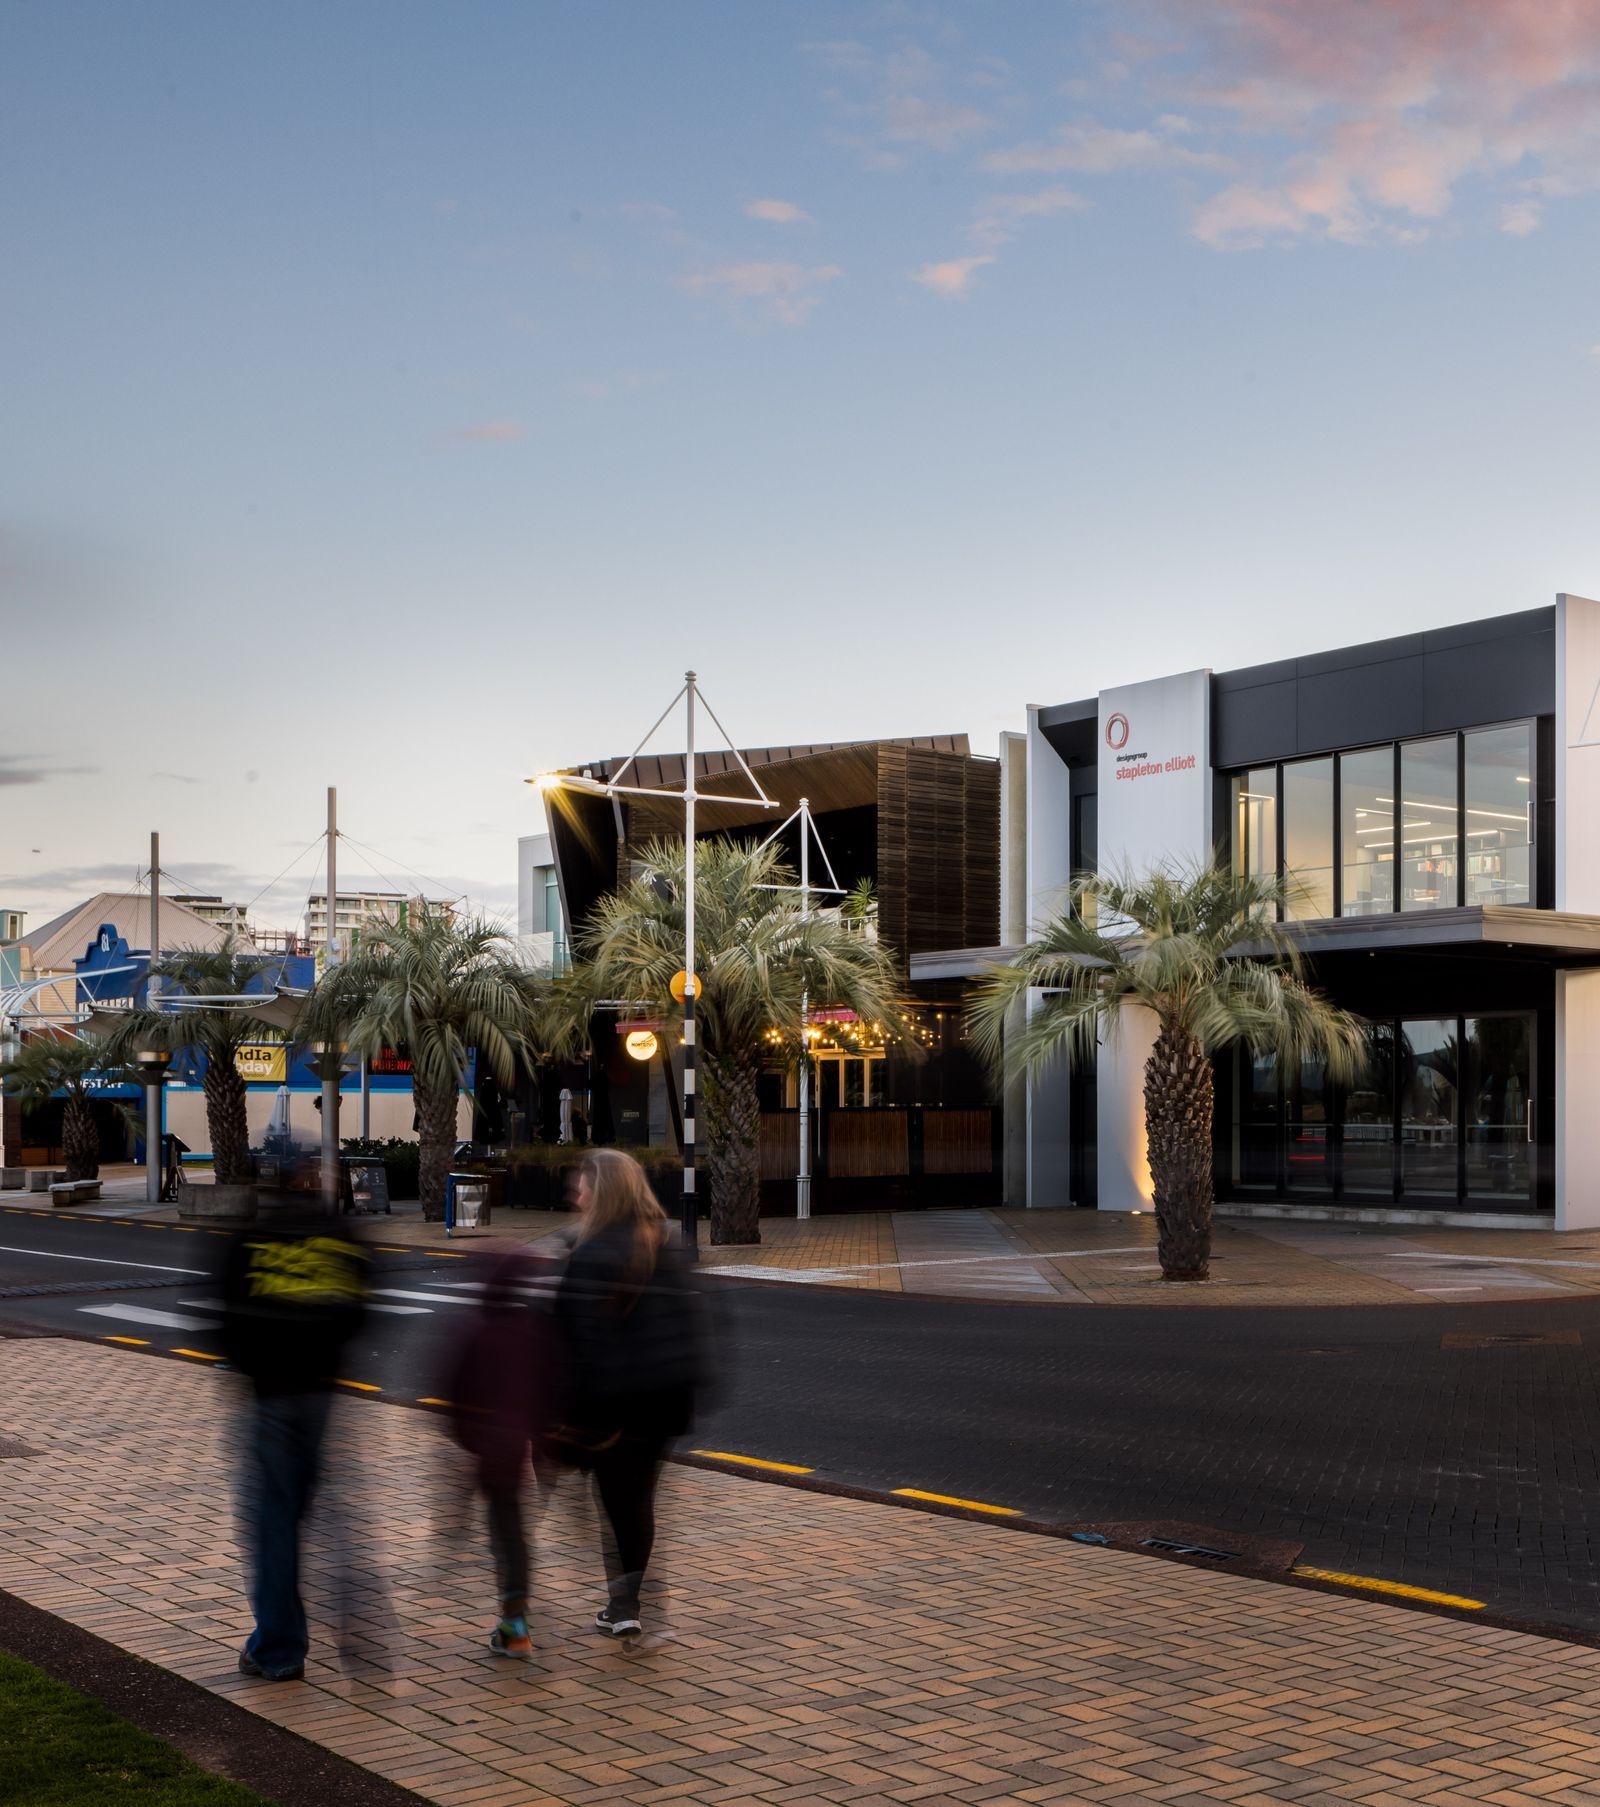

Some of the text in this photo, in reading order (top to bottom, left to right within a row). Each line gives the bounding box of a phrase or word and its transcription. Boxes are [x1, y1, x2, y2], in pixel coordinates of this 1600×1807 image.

[1116, 755, 1196, 780] stapleton elliott
[101, 933, 110, 952] 81
[236, 1049, 272, 1061] ndIa
[237, 1061, 274, 1075] oday
